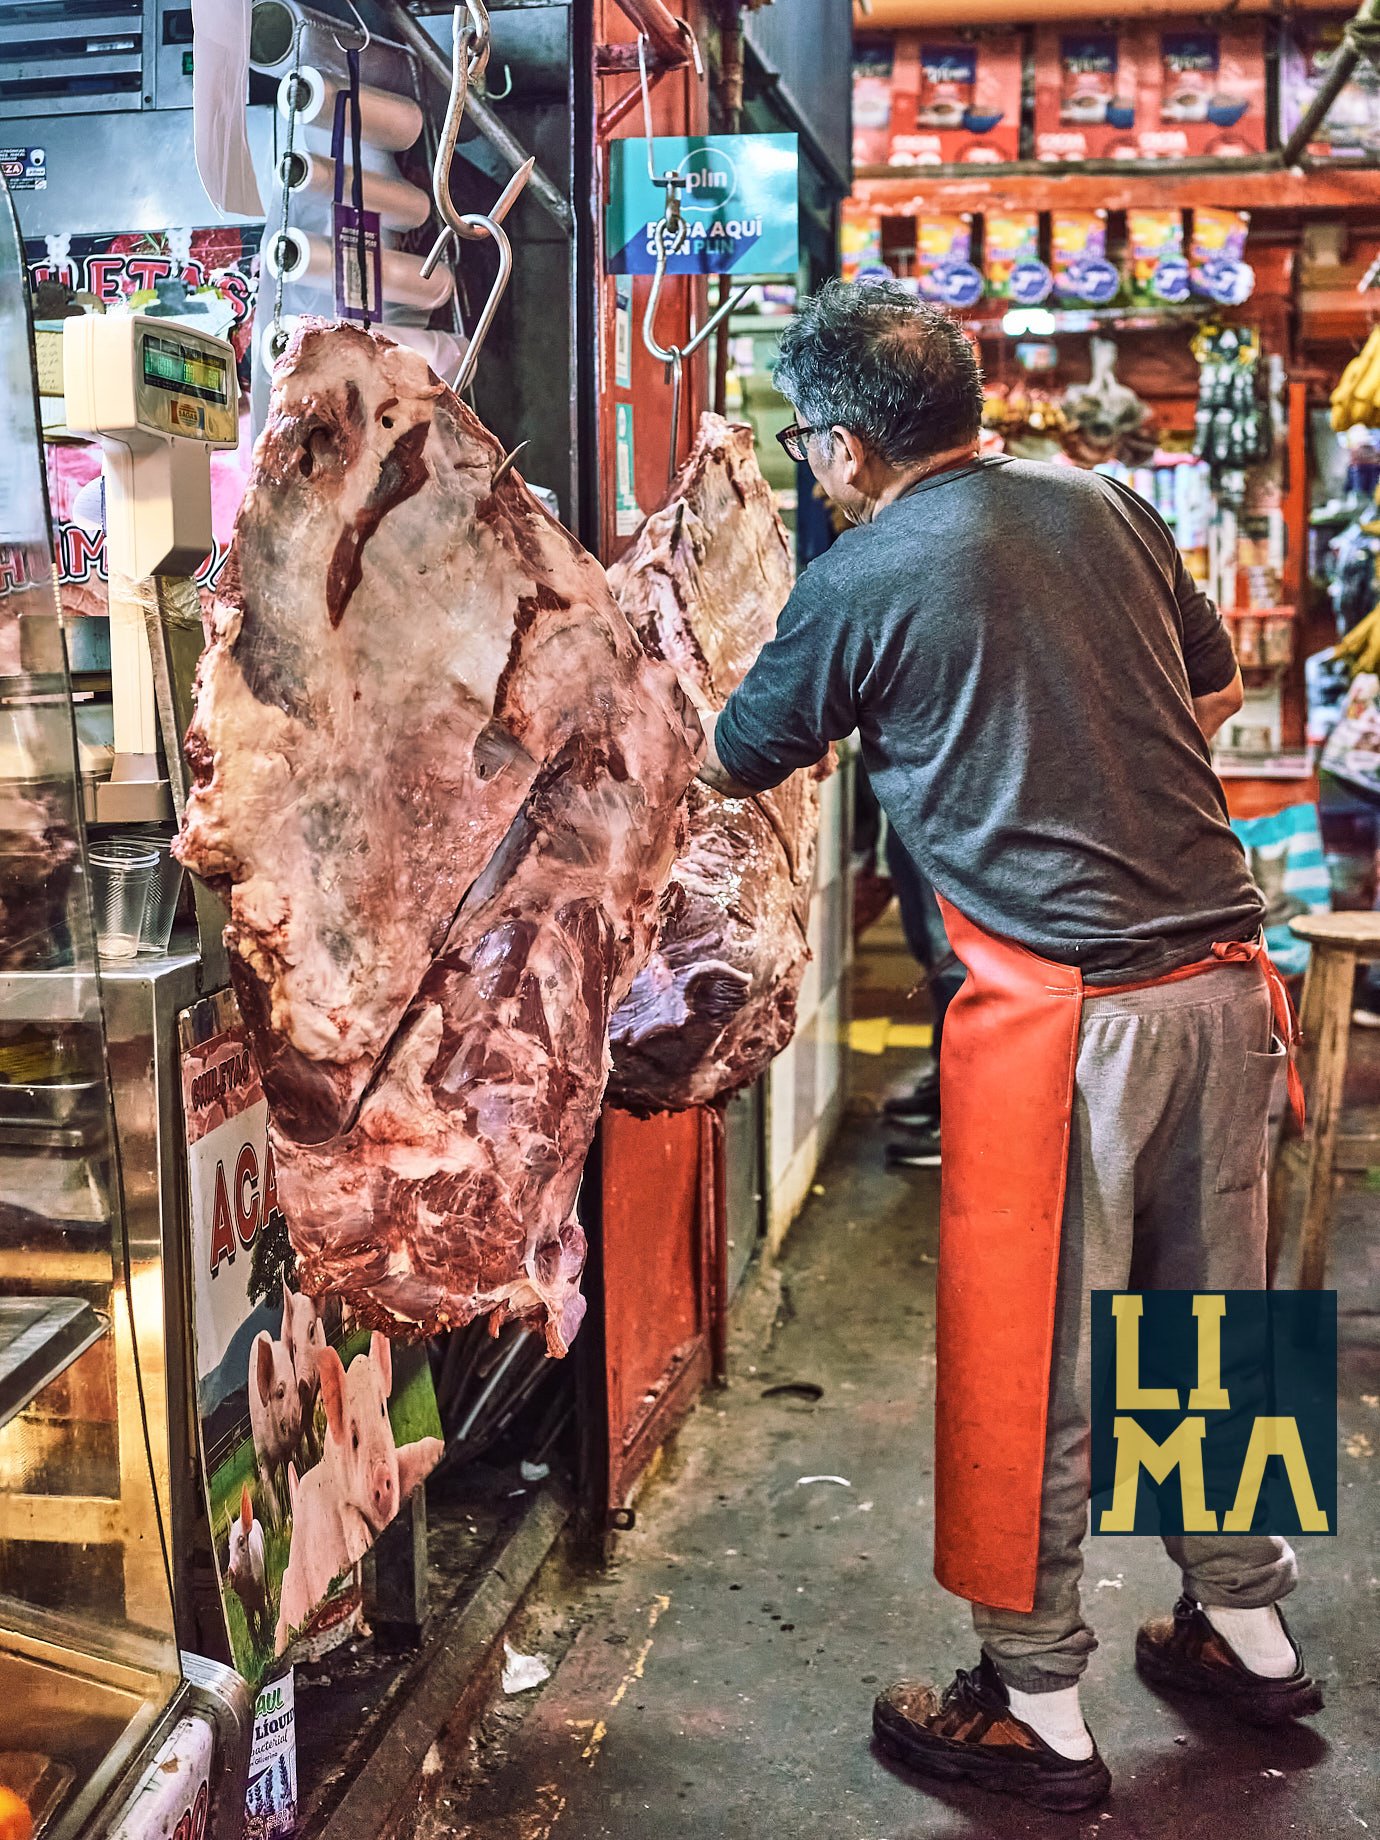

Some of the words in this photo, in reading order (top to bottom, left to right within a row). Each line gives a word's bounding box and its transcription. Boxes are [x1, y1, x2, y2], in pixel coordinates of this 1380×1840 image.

[685, 168, 728, 193] plin
[709, 215, 763, 239] AQUÍ
[693, 239, 735, 255] PLIN
